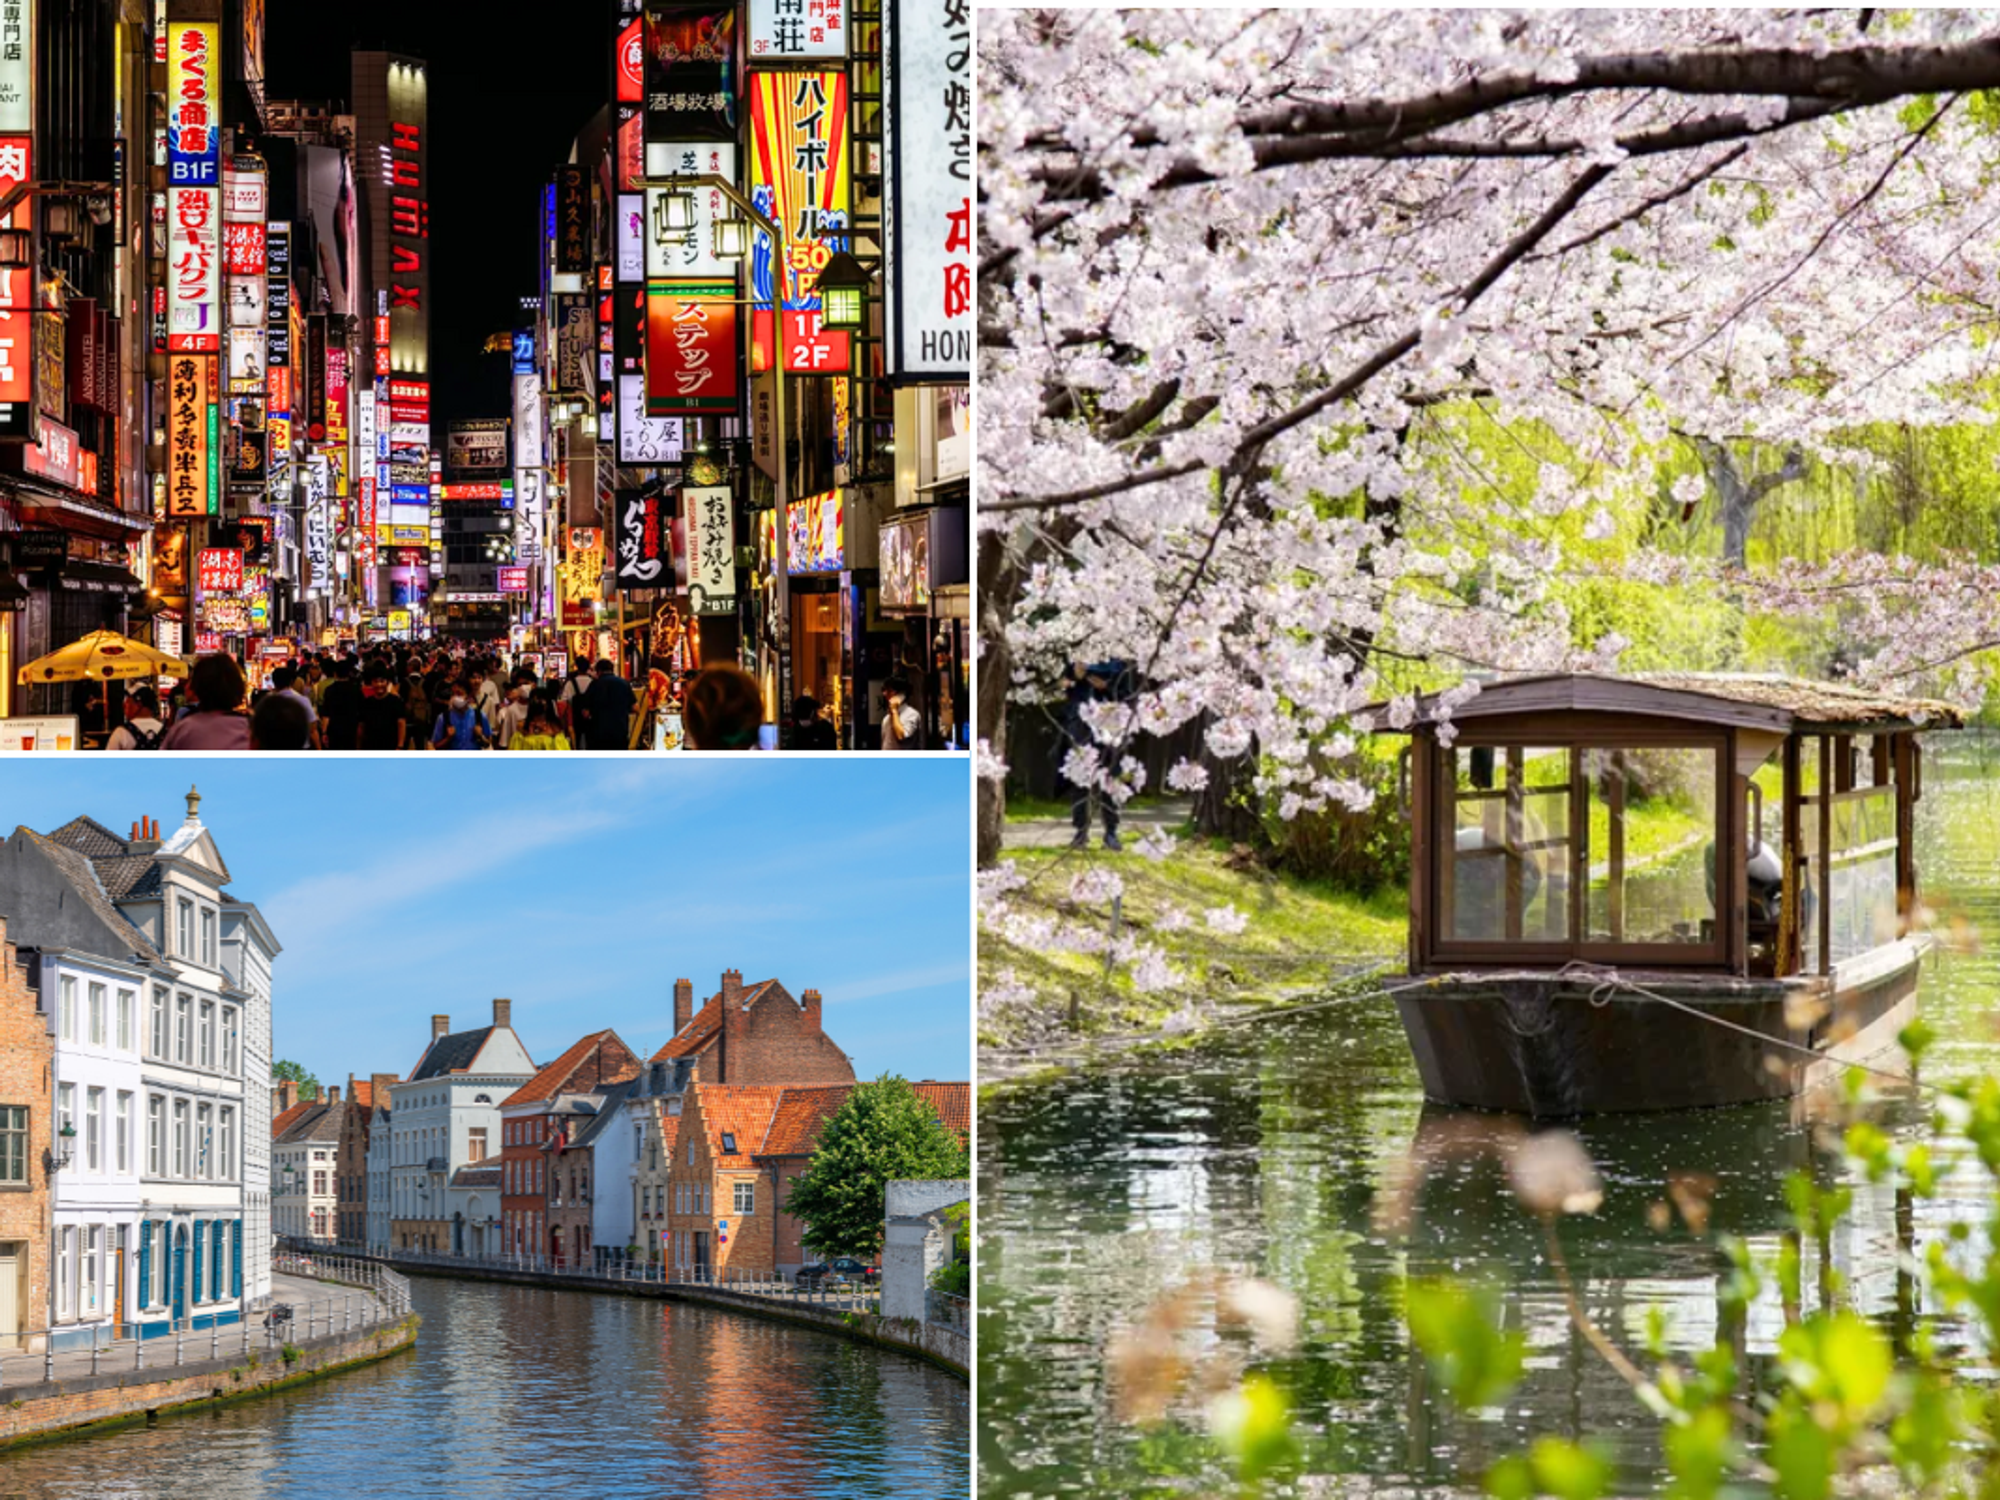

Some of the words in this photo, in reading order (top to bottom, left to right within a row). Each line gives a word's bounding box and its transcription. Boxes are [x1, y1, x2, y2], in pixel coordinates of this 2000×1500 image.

[754, 39, 770, 53] 3F
[179, 29, 207, 152] まぐろ商店
[619, 107, 632, 118] 3F
[172, 160, 215, 180] B1F
[794, 80, 827, 239] ハイボール
[795, 315, 822, 336] 1F
[182, 336, 207, 350] 4F
[671, 298, 712, 394] ステップ
[921, 329, 969, 361] HON
[793, 346, 830, 367] 2F
[701, 495, 732, 585] お好み焼き
[712, 600, 735, 611] B1F
